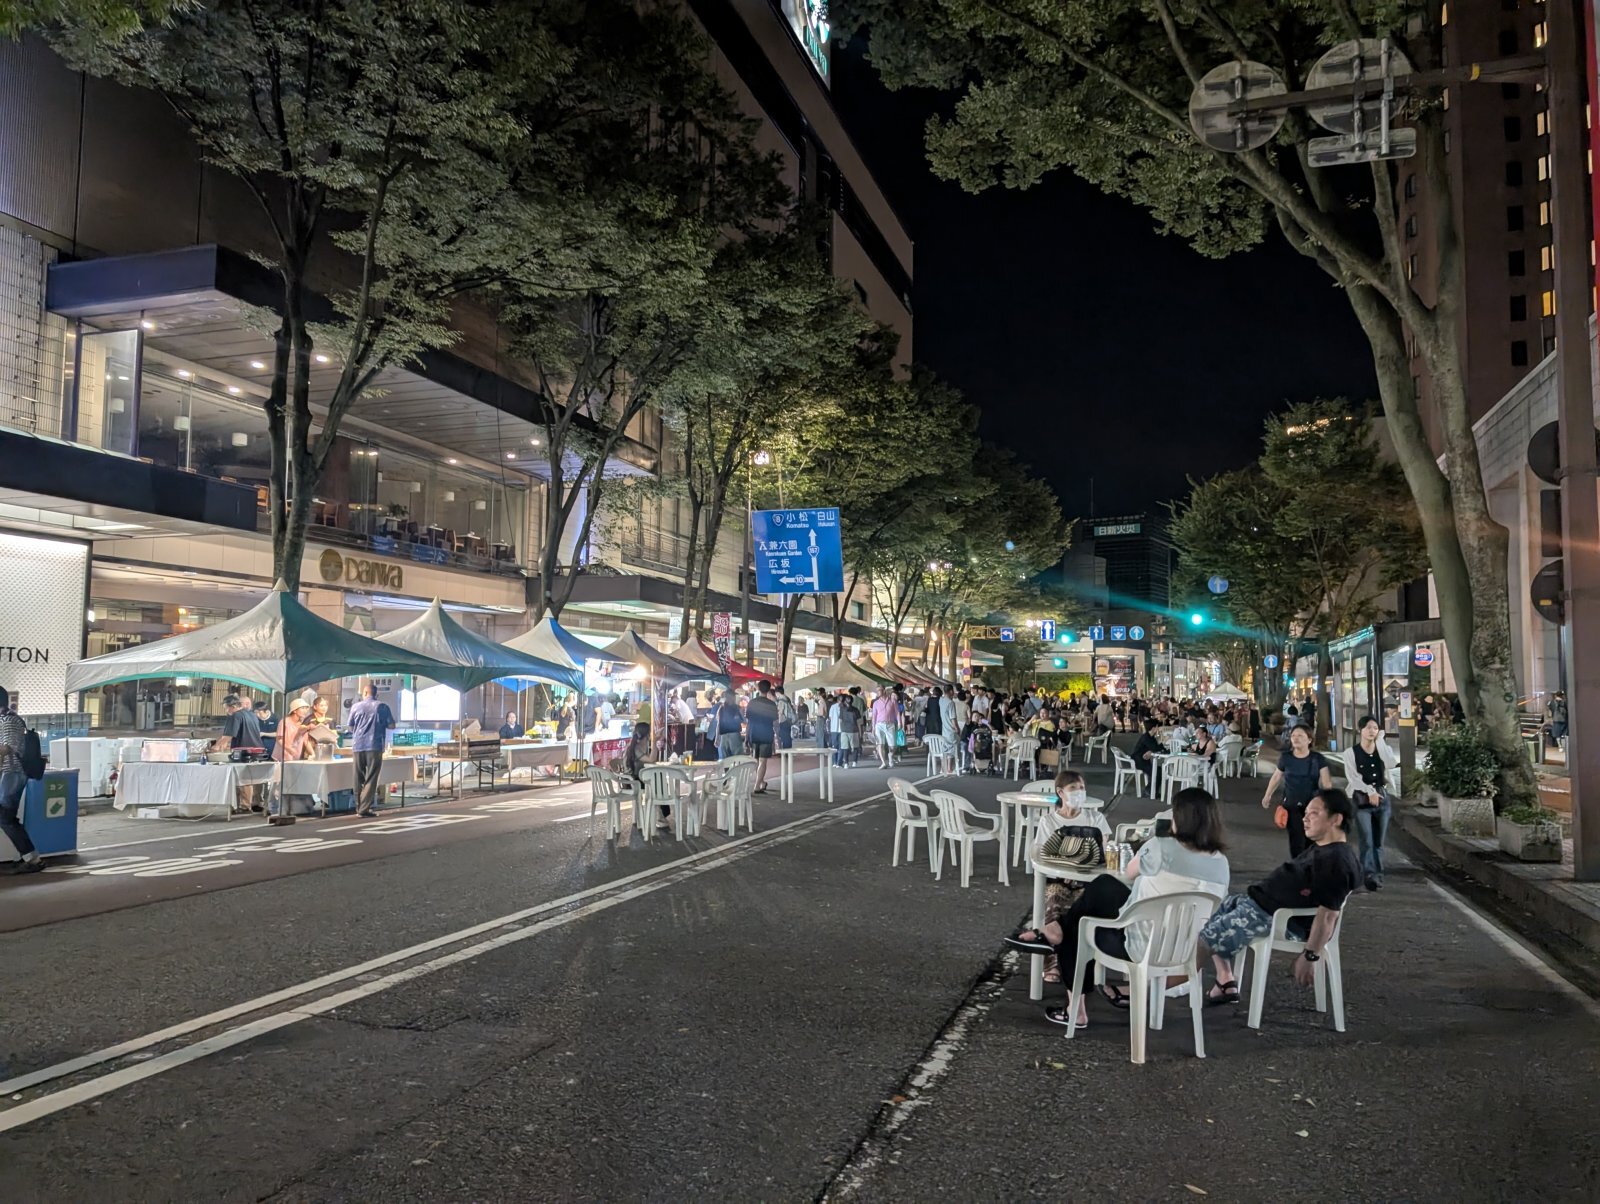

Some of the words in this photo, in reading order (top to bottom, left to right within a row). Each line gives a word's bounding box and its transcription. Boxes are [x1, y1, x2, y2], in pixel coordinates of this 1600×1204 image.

[786, 512, 808, 522] 小松
[818, 511, 835, 521] 白山
[769, 540, 797, 550] 兼六園
[768, 558, 790, 568] 広坂
